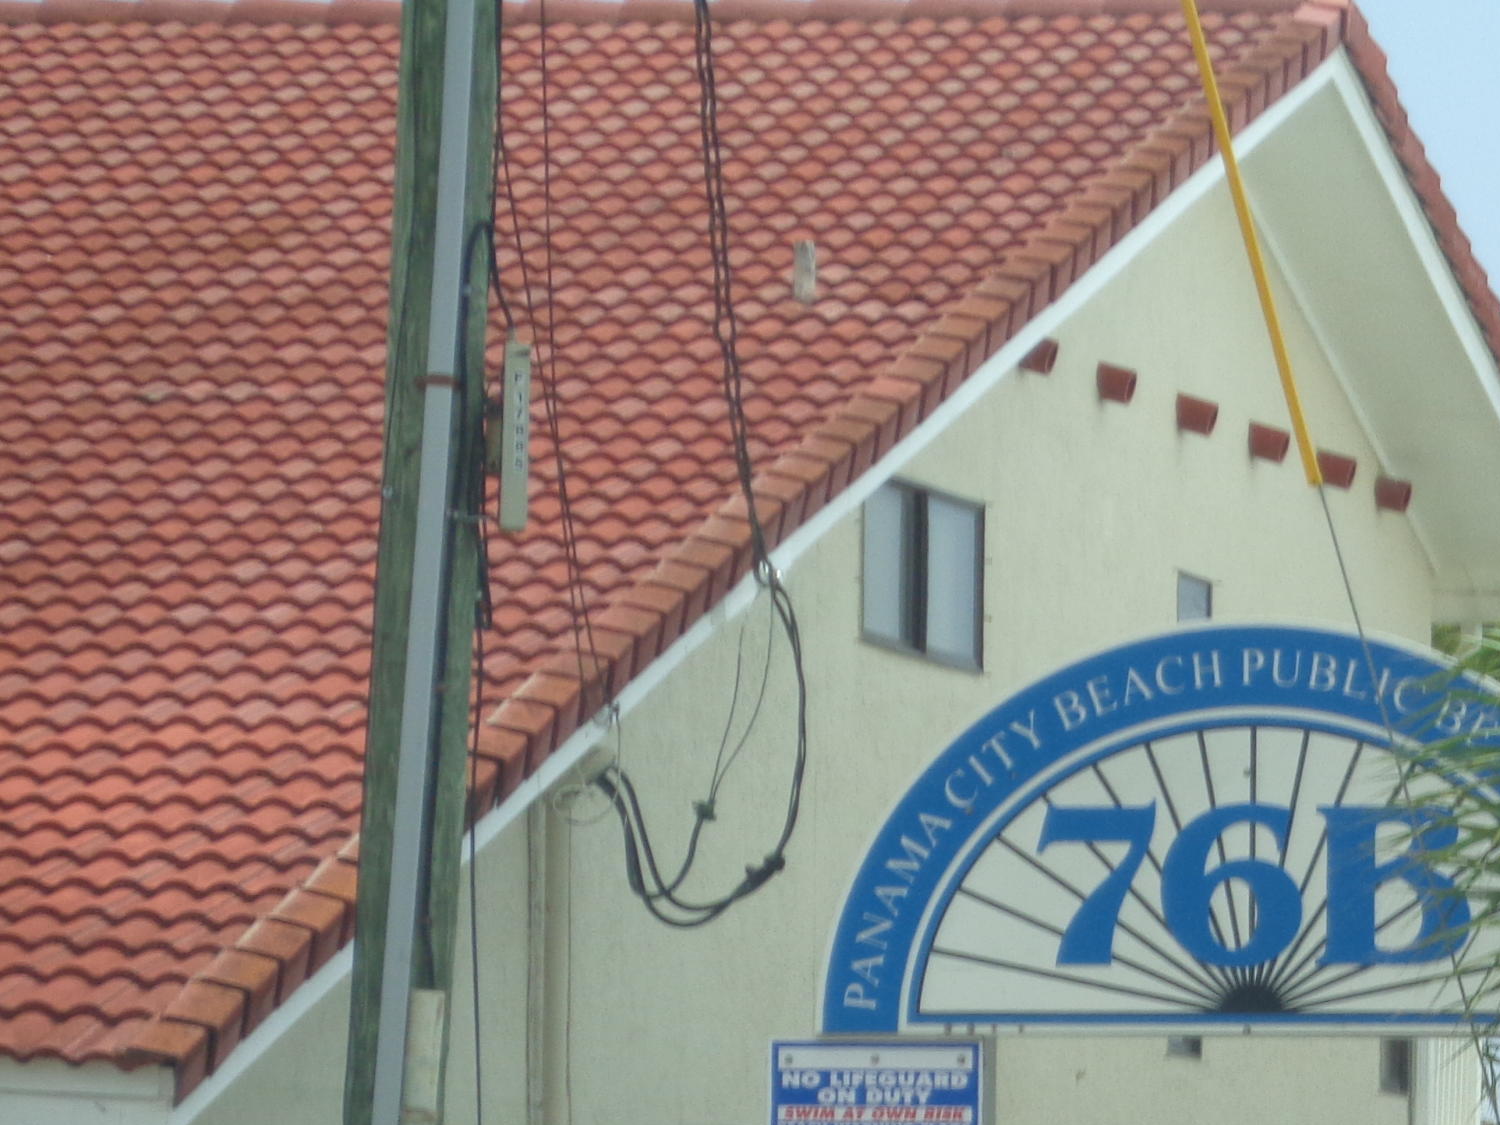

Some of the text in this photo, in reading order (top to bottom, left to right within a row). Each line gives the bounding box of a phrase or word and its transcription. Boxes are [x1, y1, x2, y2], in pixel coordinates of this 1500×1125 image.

[843, 647, 1427, 1011] PANAMA CITY BEACH PUBLIC
[1036, 797, 1472, 968] 76B
[782, 1070, 968, 1090] NO LIFEGUARD
[817, 1087, 932, 1106] ON DUTY
[785, 1107, 965, 1120] SWIM AT OWN RISK
